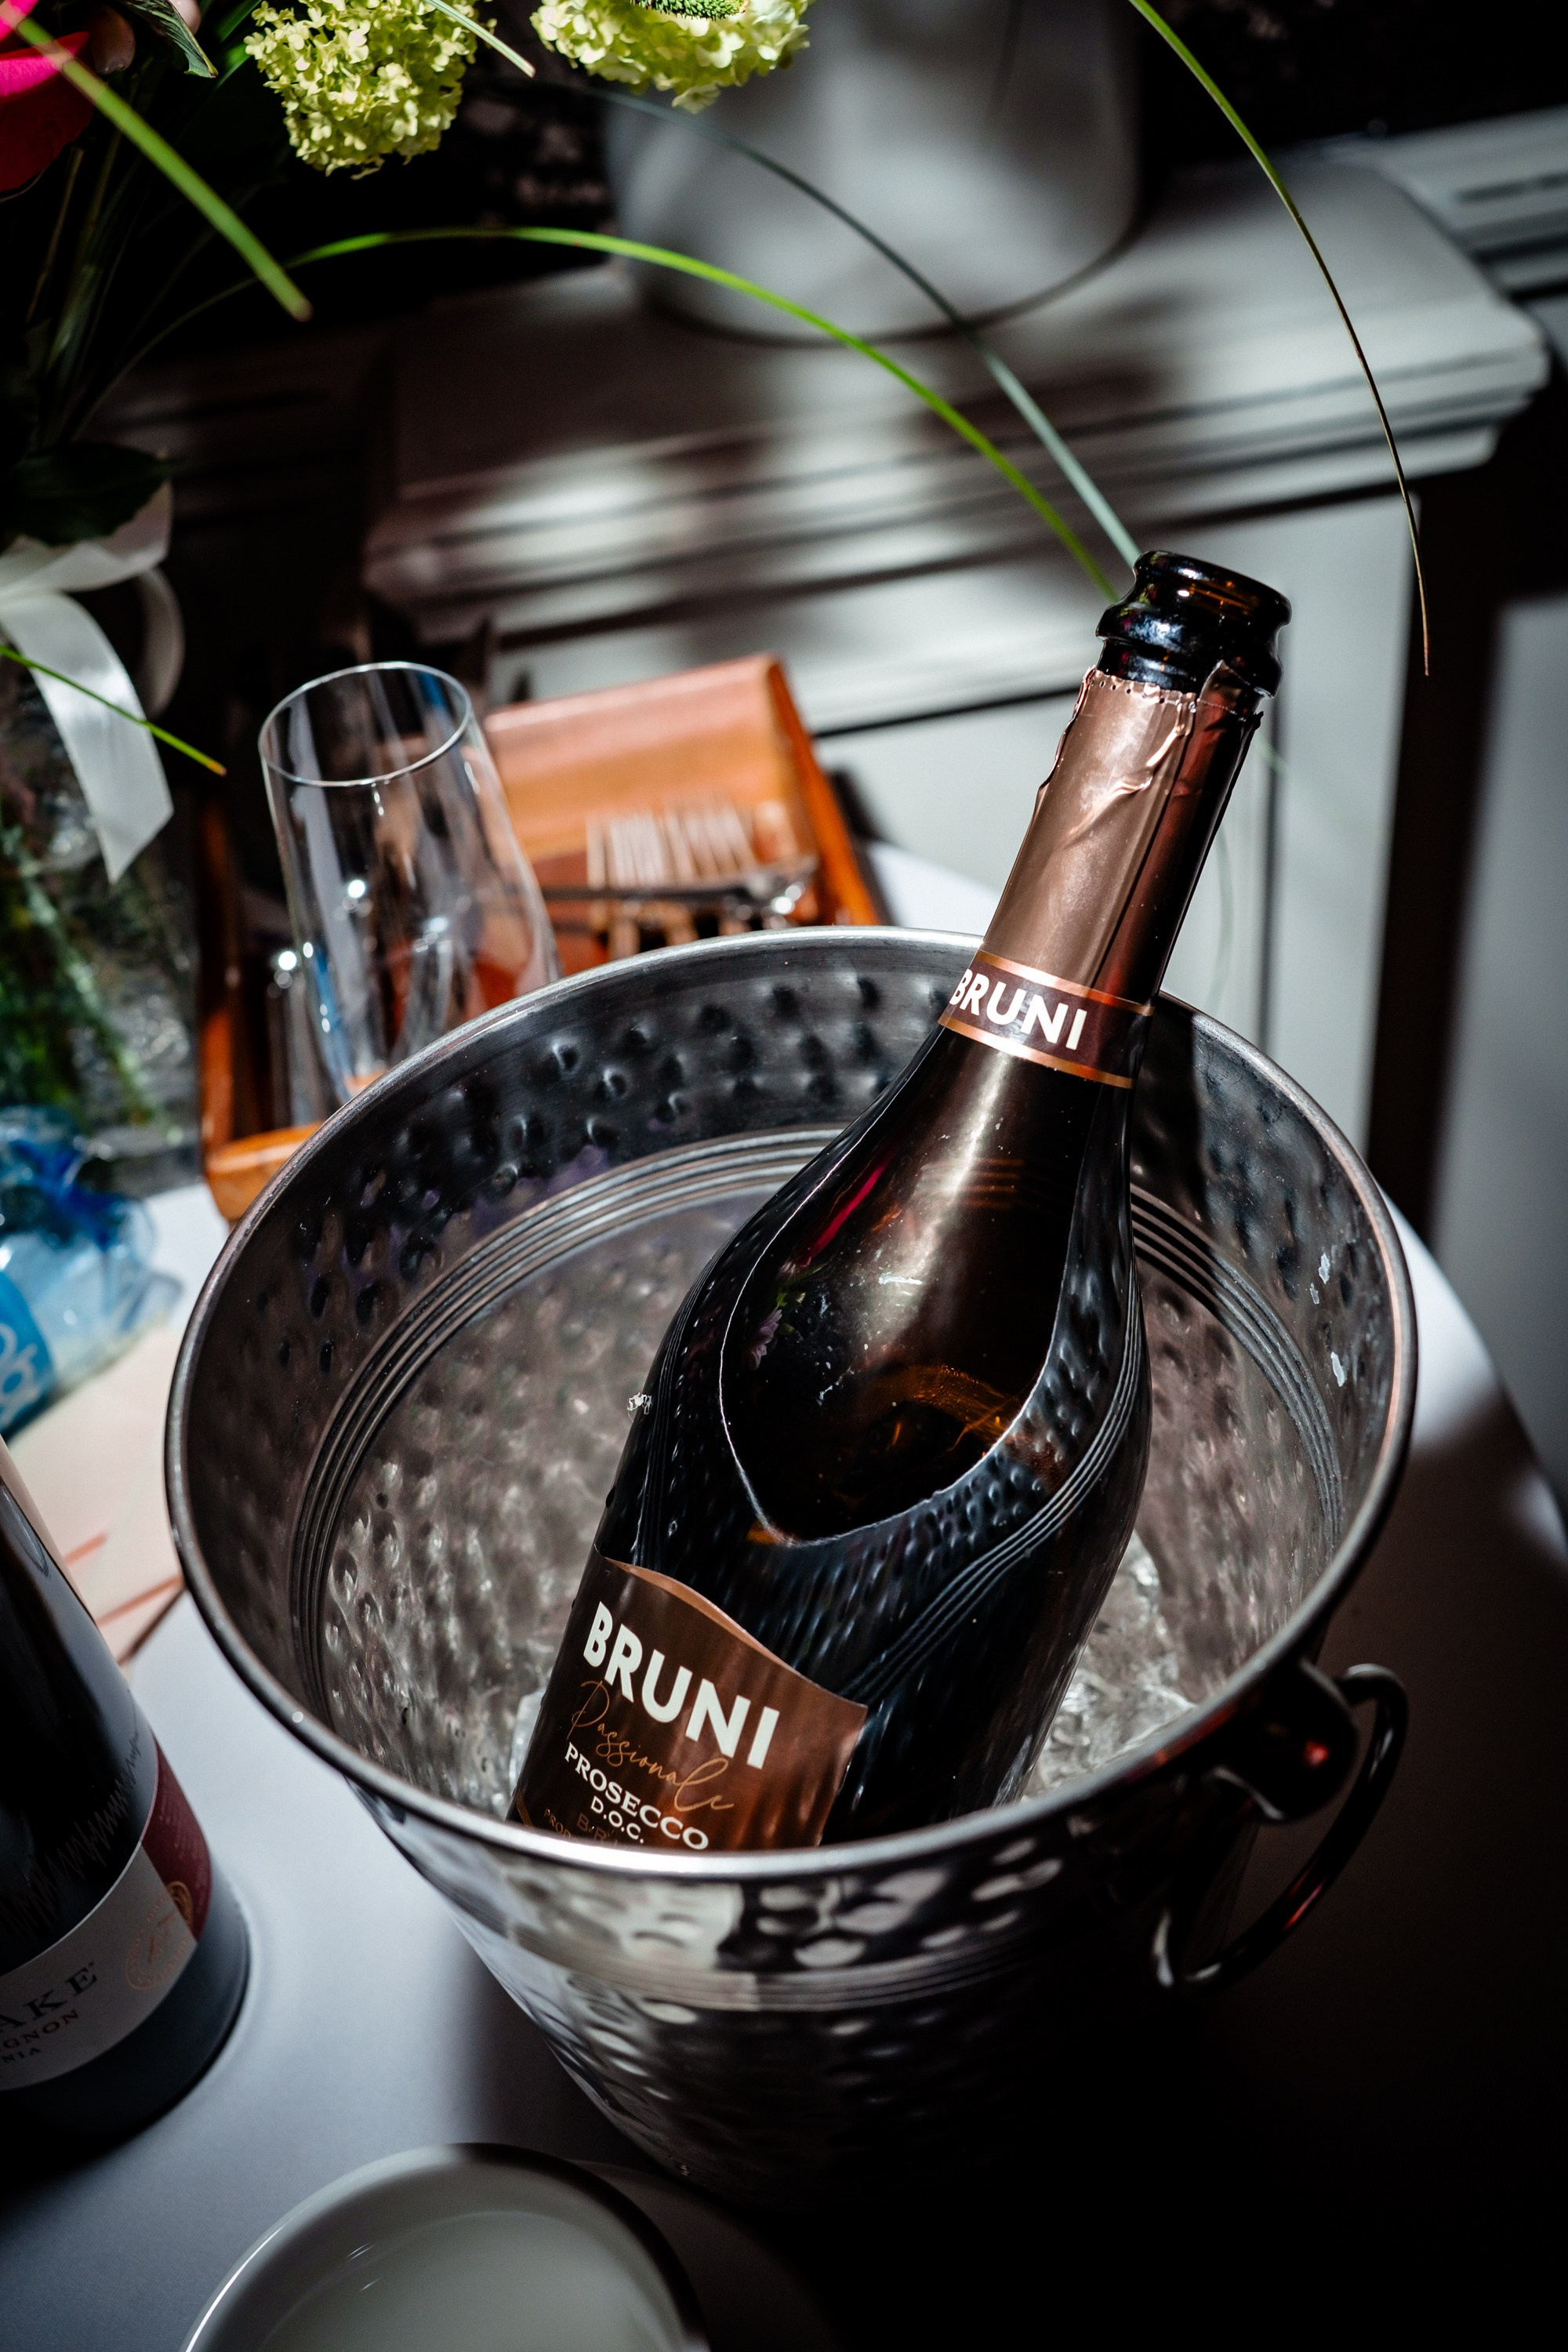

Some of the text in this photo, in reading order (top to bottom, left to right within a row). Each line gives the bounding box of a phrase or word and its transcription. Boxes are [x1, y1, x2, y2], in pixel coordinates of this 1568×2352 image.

[949, 968, 1087, 1051] BRUNI
[583, 1601, 780, 1769] BRUNI
[564, 1742, 709, 1850] PROSECCO
[566, 1680, 735, 1812] Passionale
[590, 1795, 644, 1844] D.O.C.
